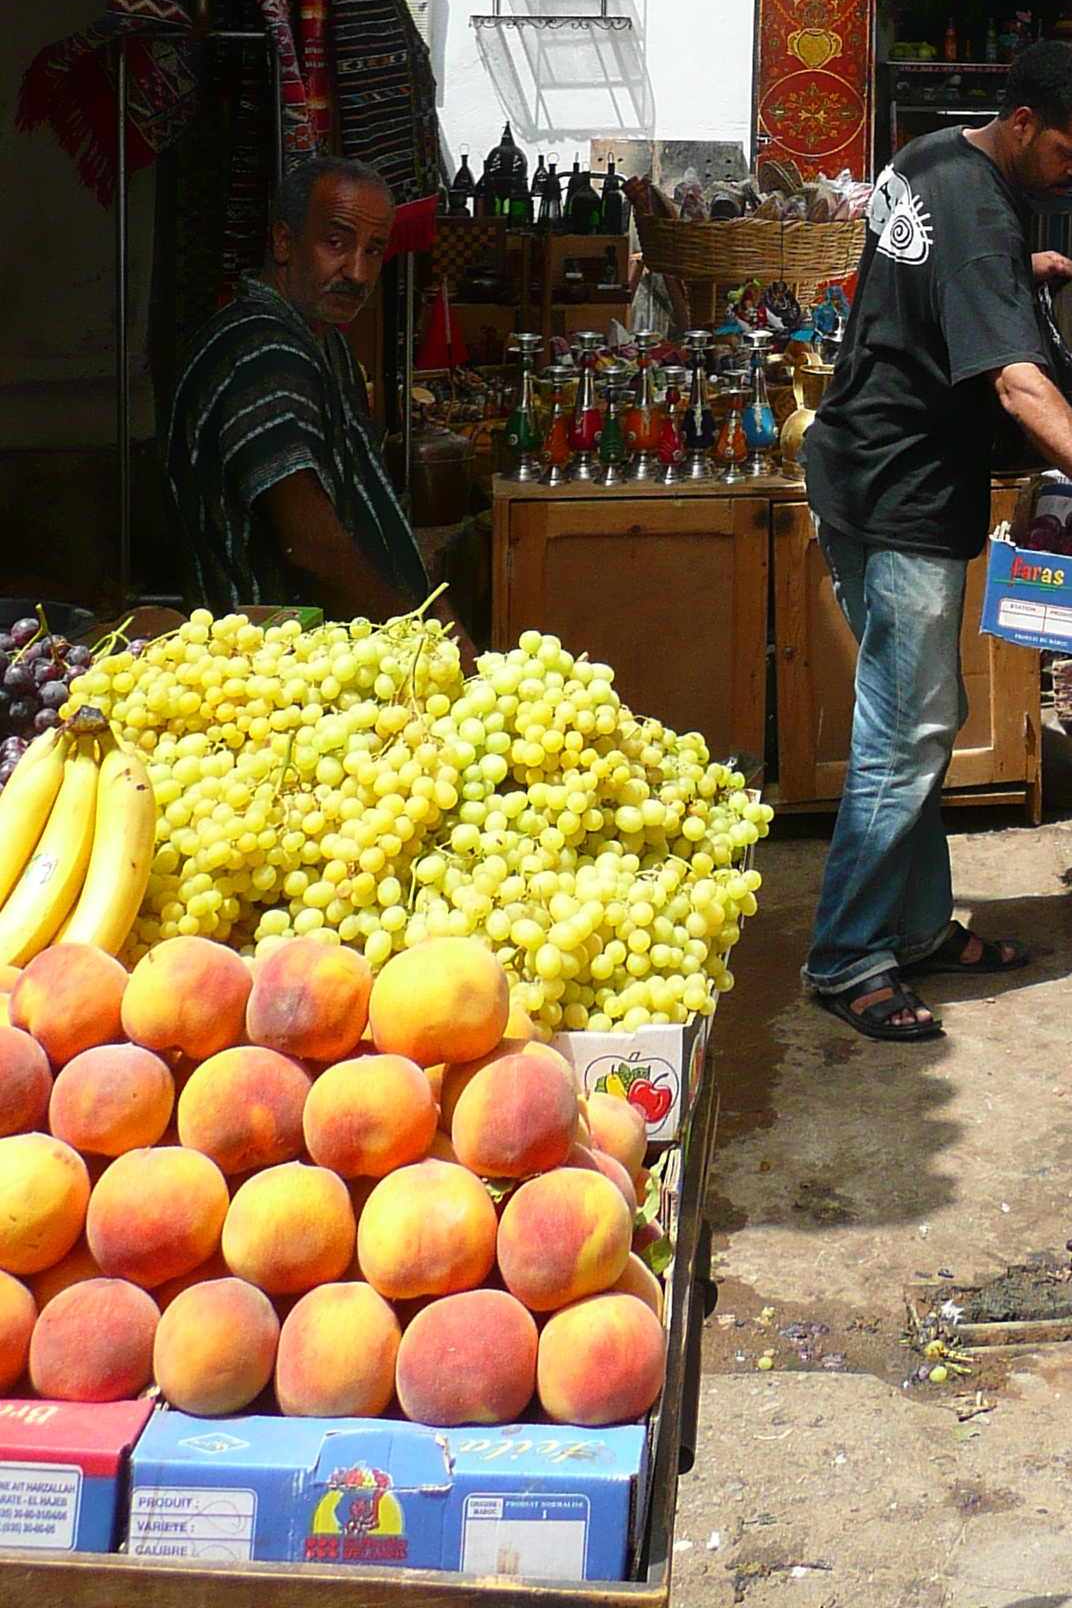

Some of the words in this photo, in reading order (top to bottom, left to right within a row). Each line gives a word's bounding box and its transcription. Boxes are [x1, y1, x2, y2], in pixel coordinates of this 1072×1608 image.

[1007, 556, 1065, 587] faras
[138, 1497, 193, 1508] PRODUIT
[135, 1545, 188, 1556] CALIBRE
